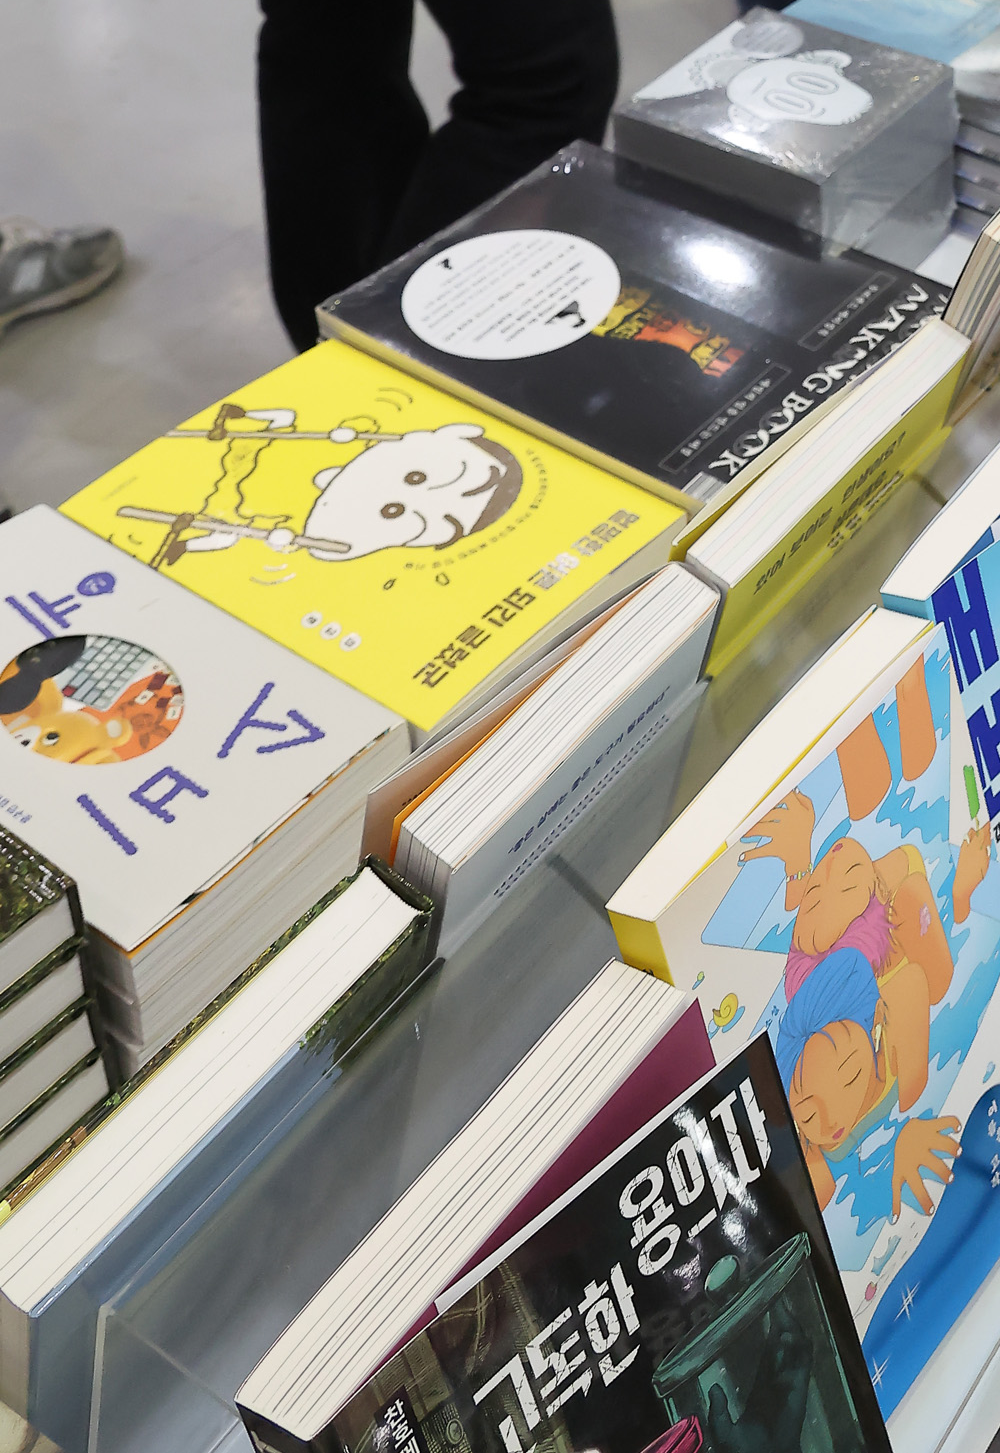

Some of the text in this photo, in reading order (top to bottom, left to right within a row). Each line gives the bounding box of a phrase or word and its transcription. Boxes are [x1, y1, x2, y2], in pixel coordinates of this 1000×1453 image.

[707, 390, 813, 476] BOOK
[481, 587, 536, 632] 되긴
[412, 625, 490, 689] 글렀군
[618, 1076, 772, 1277] 용의자
[472, 1261, 642, 1453] 고독한
